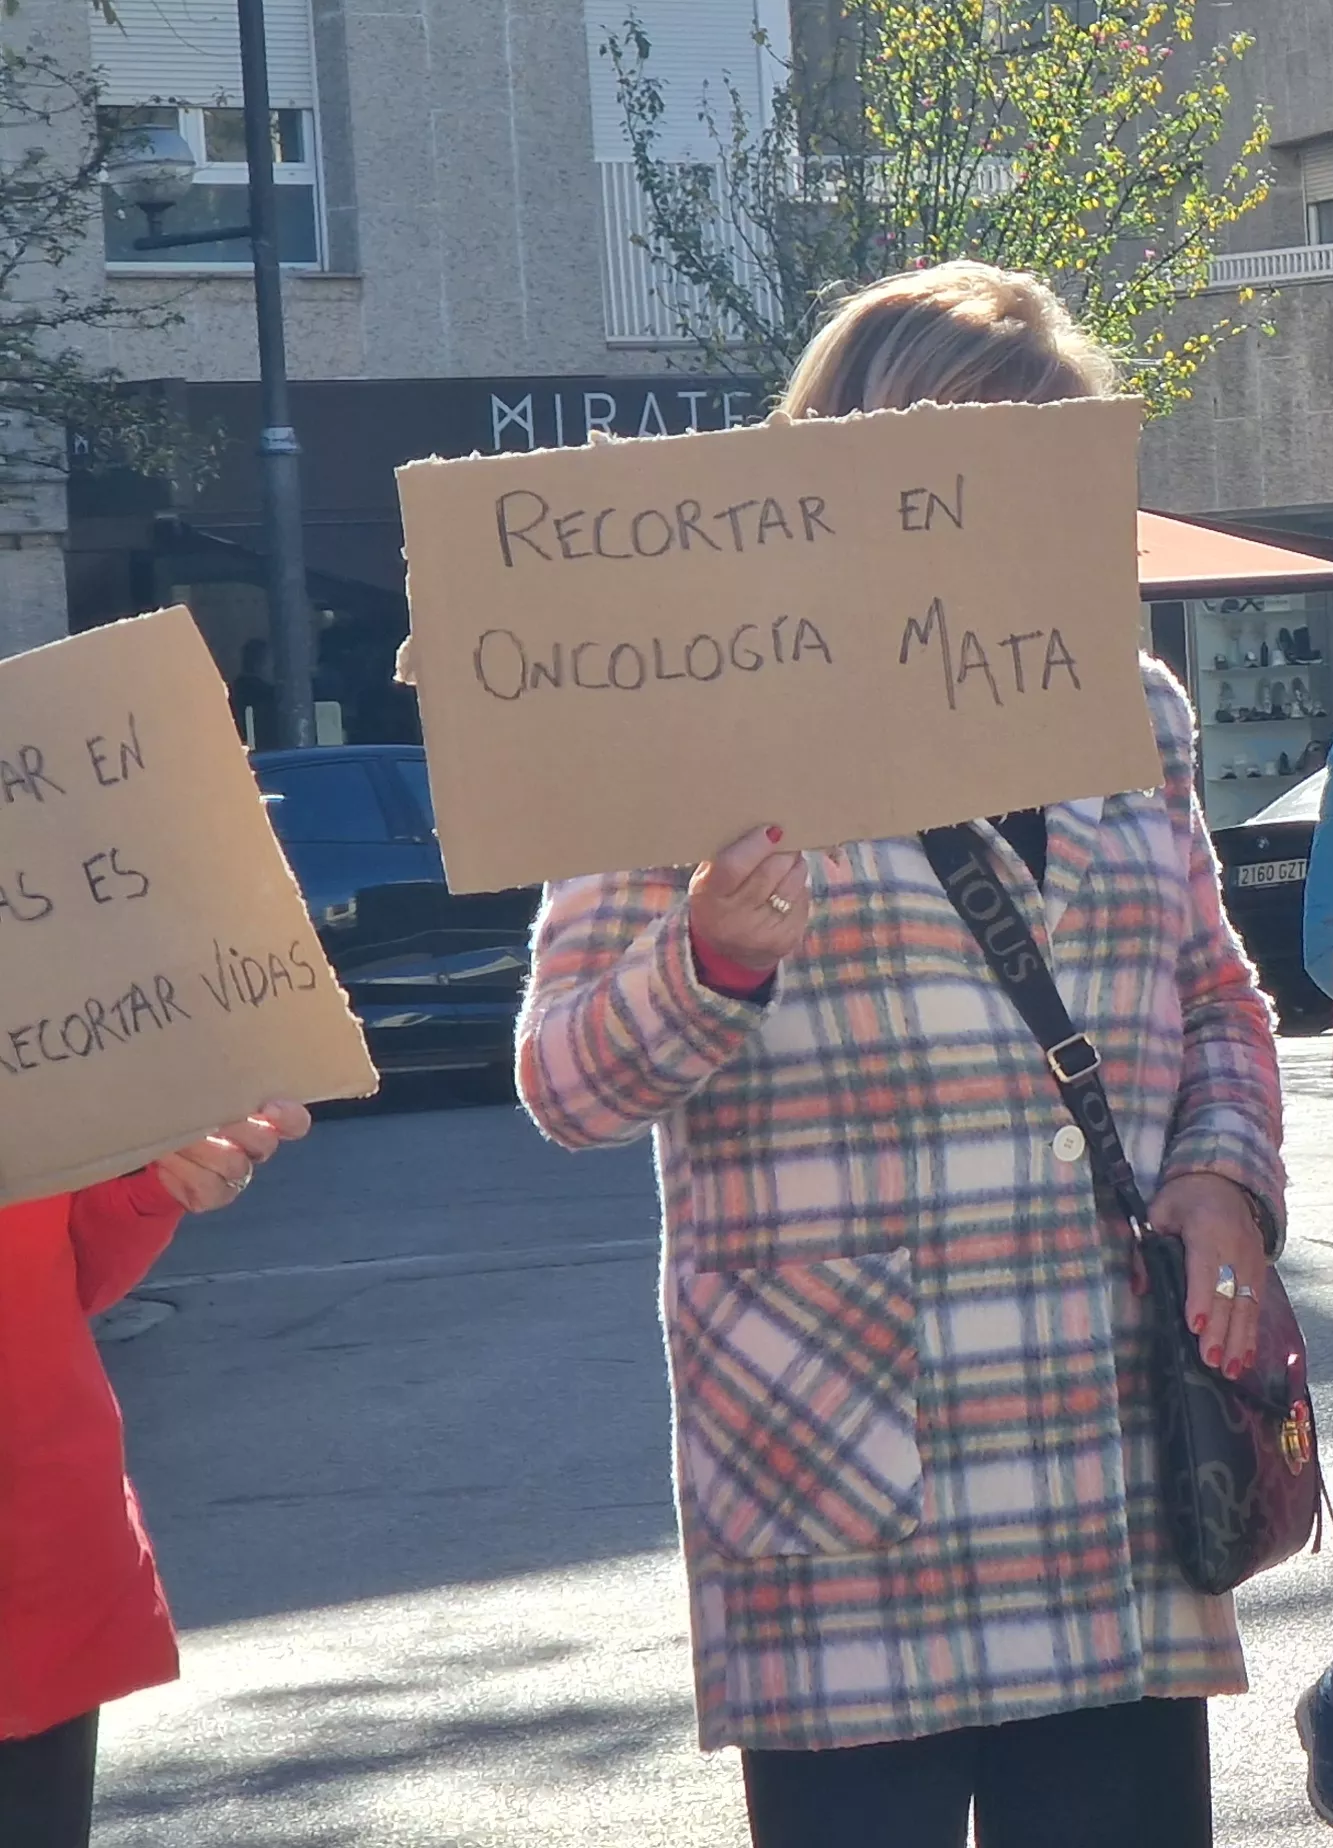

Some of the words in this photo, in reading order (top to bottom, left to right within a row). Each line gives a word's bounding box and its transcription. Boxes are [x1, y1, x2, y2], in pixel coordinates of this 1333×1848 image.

[496, 490, 835, 567] RECORTAR
[899, 474, 964, 532] EN
[474, 616, 833, 700] ONCOLOGÍA
[900, 597, 1081, 709] MATA
[86, 713, 145, 786] EN
[82, 847, 149, 904] ES
[946, 851, 1038, 983] TOUS
[1241, 865, 1274, 885] 2160
[1279, 861, 1305, 880] GZT
[0, 975, 191, 1073] ECORTAR
